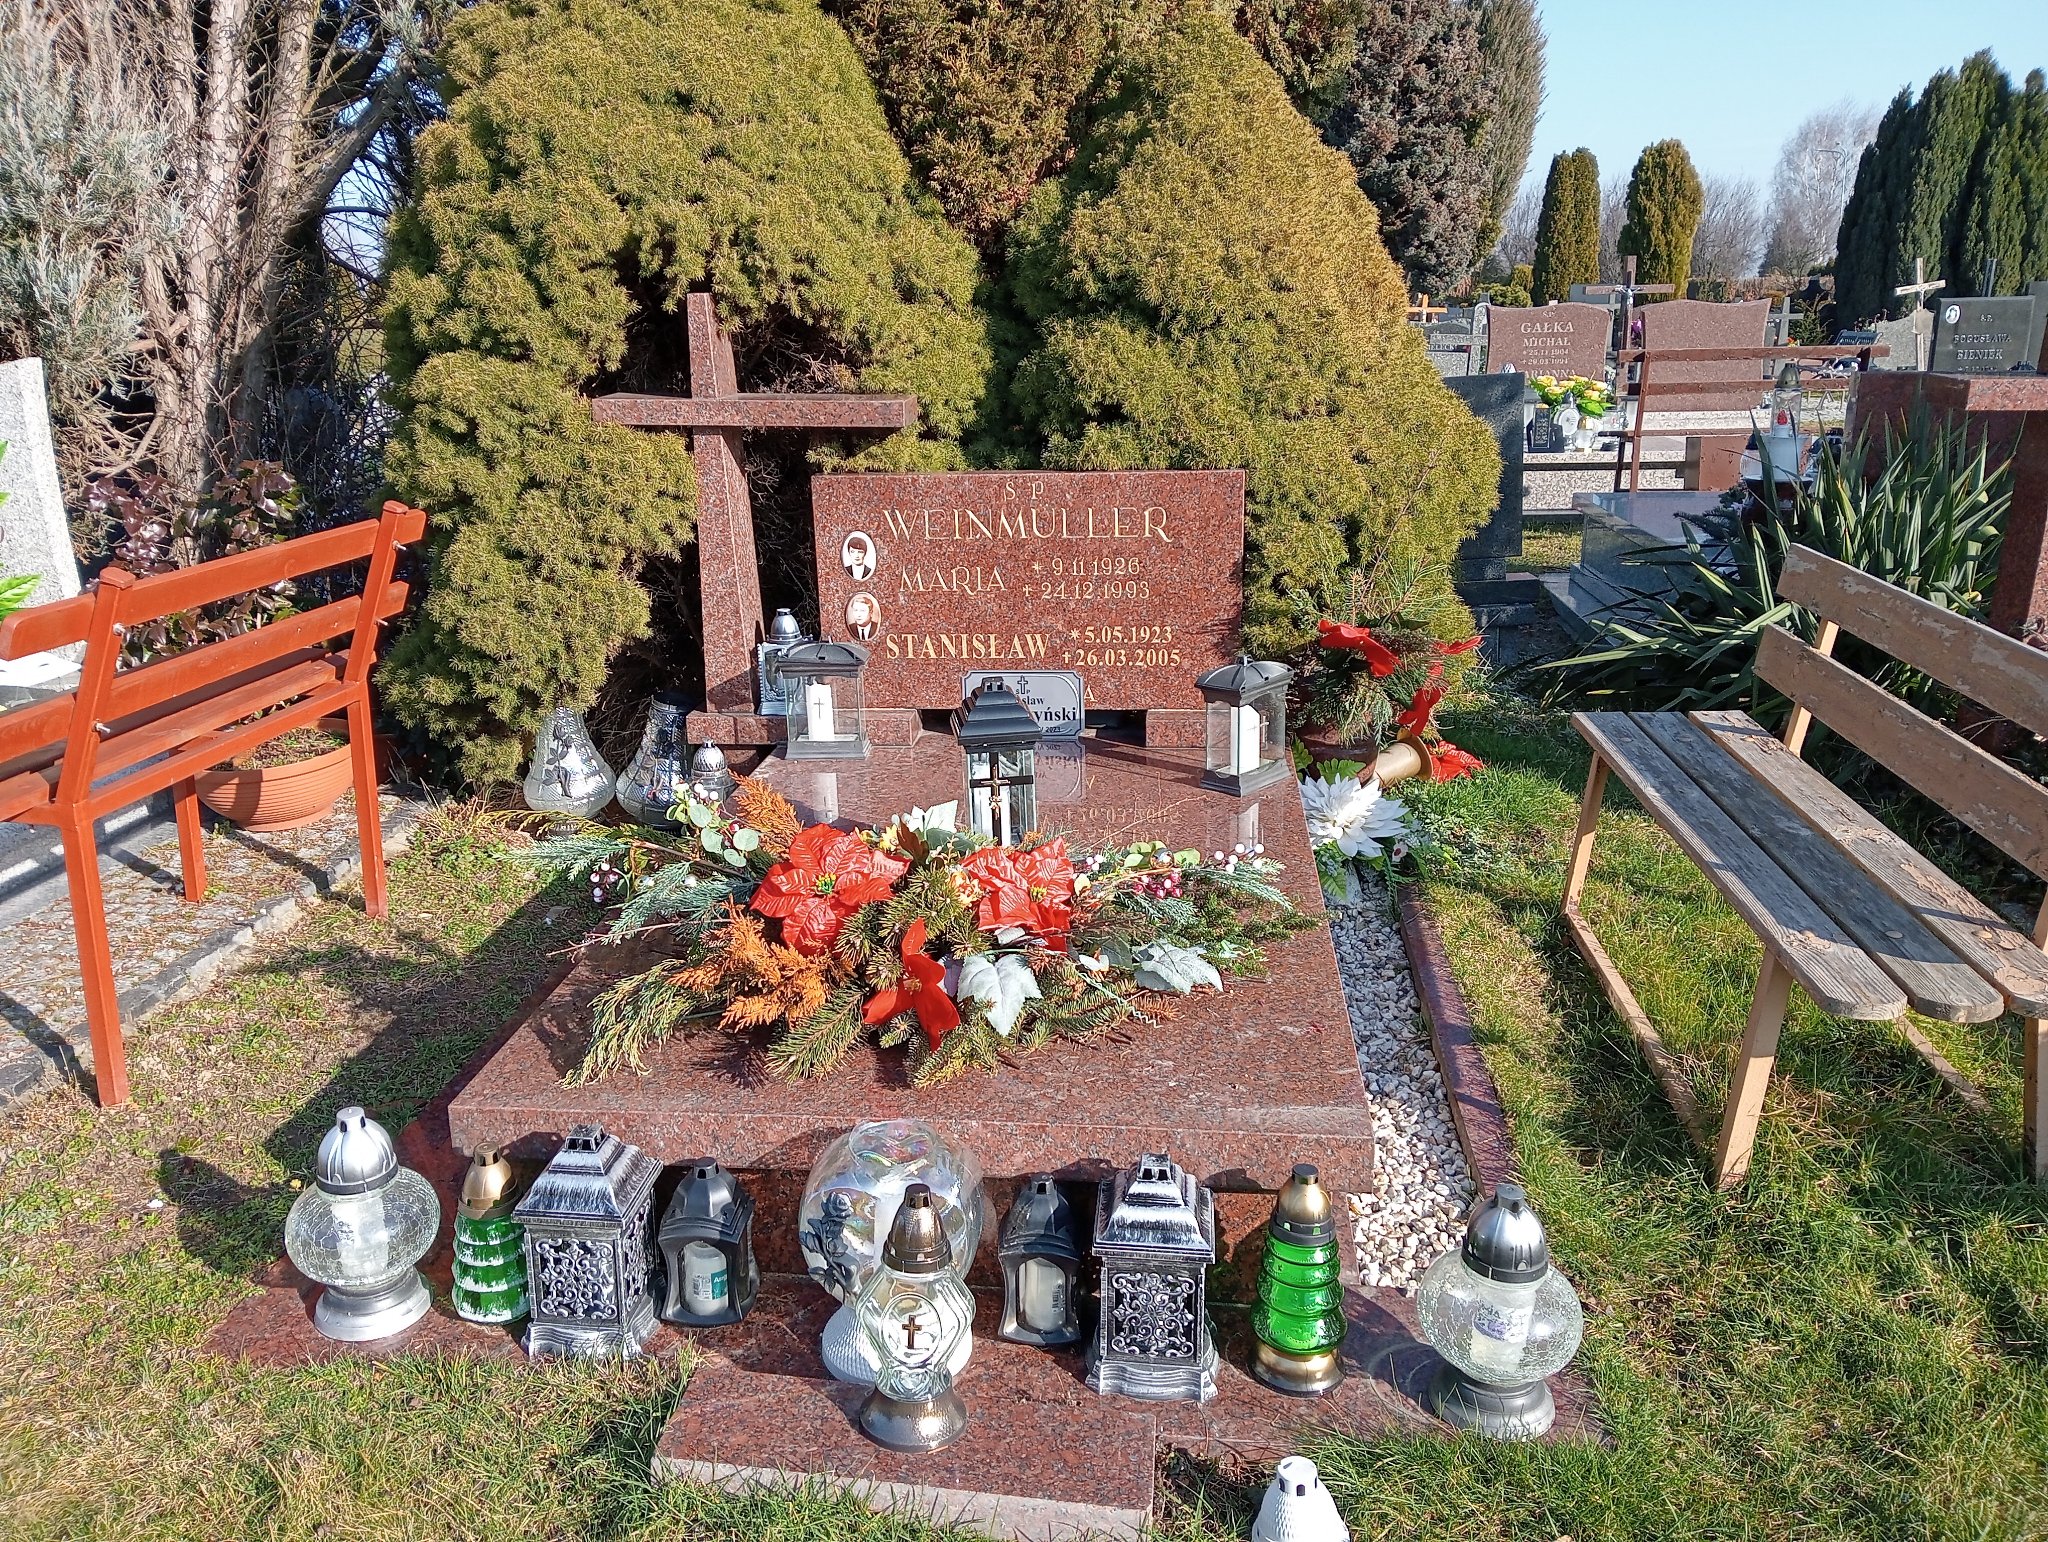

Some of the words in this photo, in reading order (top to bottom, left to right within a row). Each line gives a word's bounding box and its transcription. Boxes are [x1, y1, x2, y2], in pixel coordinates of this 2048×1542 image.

[1520, 321, 1574, 333] GAŁKA
[1523, 336, 1571, 347] MICHAŁ
[1953, 333, 2012, 343] BOGUSŁAWA
[1957, 349, 2003, 359] BIENIEK
[899, 565, 1007, 596] MARIA
[886, 633, 1049, 659] STANISŁAW
